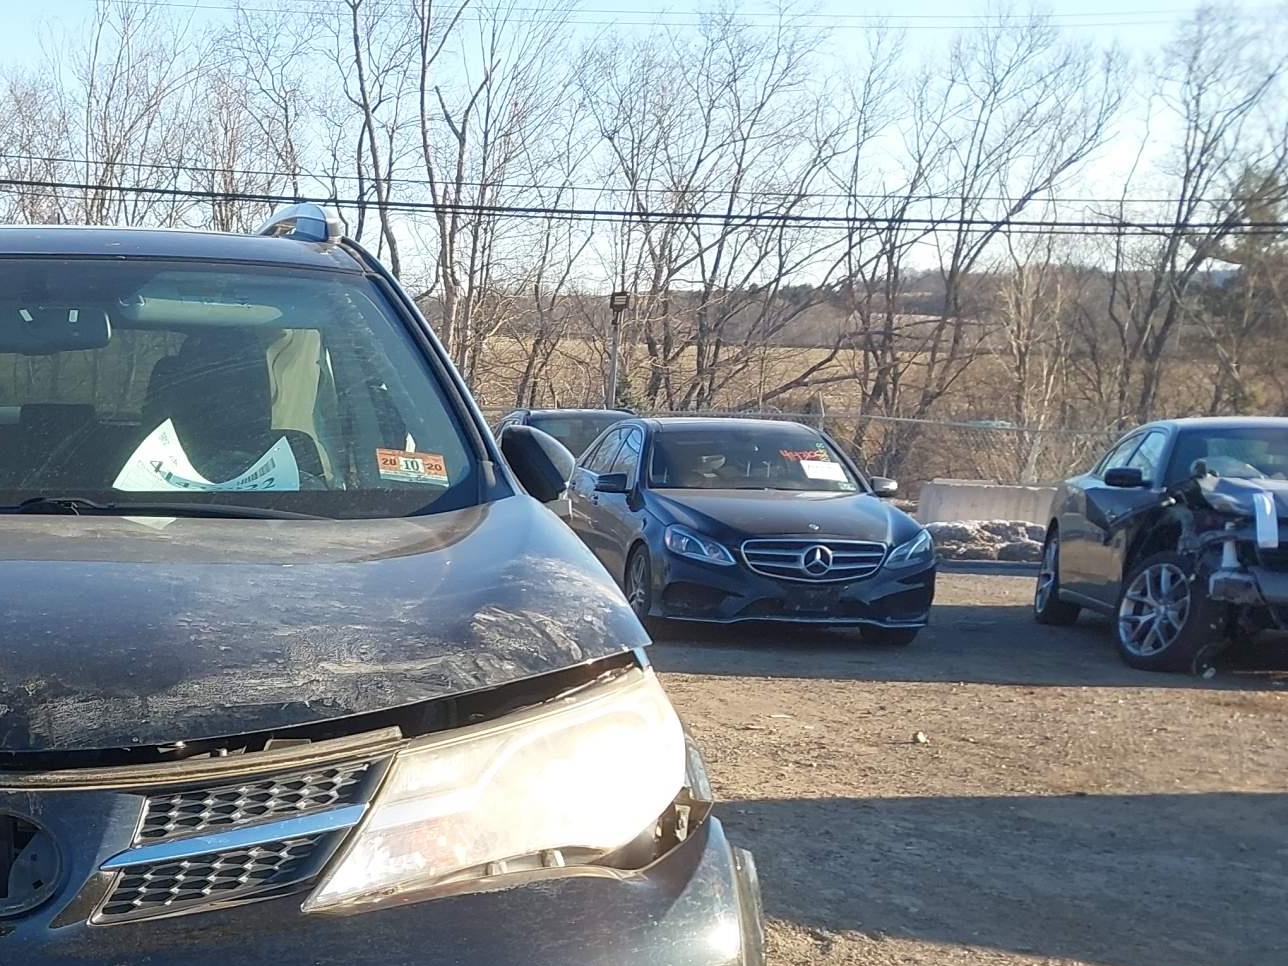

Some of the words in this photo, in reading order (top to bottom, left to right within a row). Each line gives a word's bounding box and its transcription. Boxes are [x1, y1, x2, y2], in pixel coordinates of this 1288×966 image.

[381, 457, 398, 466] 20
[403, 459, 420, 472] 10
[426, 462, 443, 472] 20
